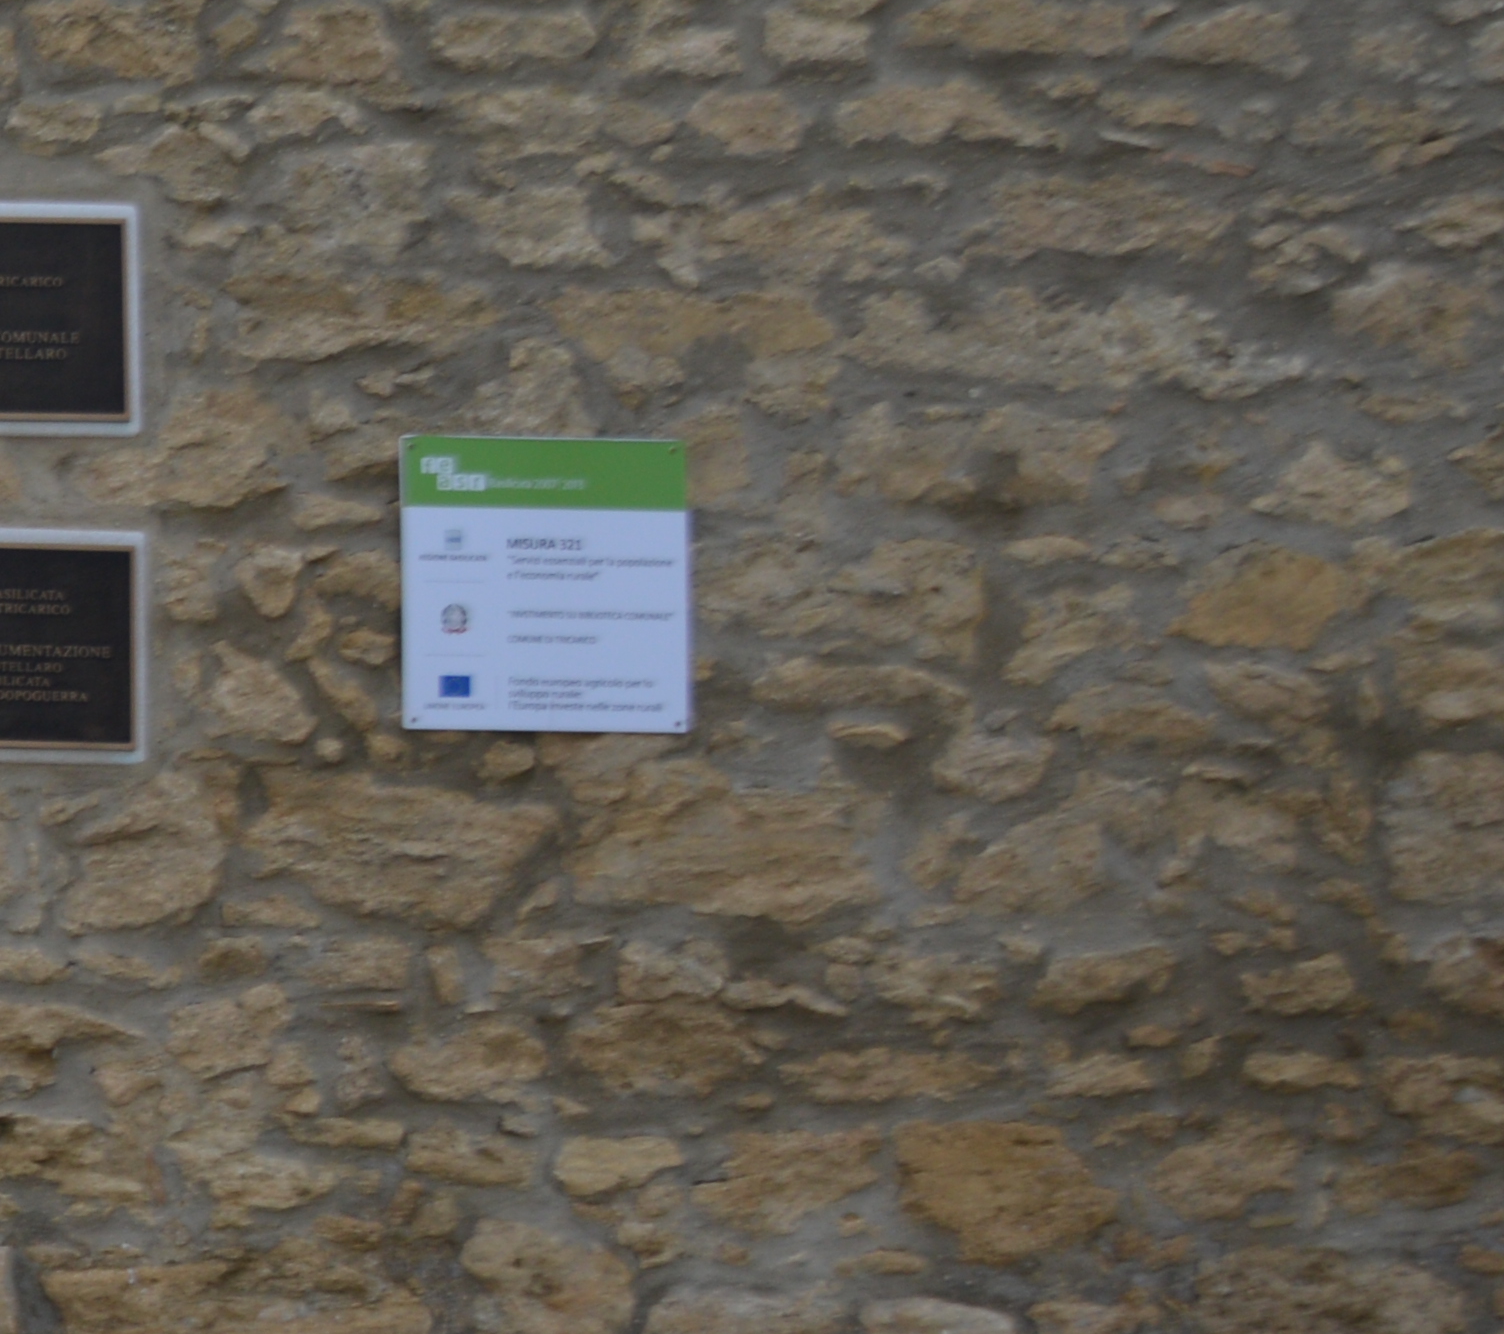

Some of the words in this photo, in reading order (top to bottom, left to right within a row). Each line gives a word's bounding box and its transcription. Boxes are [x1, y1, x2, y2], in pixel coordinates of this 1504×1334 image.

[506, 538, 556, 550] MISURA
[560, 539, 582, 551] 321
[617, 557, 672, 568] popolazione
[508, 676, 538, 687] Fondo
[541, 679, 582, 689] europeo
[585, 678, 623, 689] agricolo
[625, 680, 641, 690] per
[550, 702, 583, 711] investe
